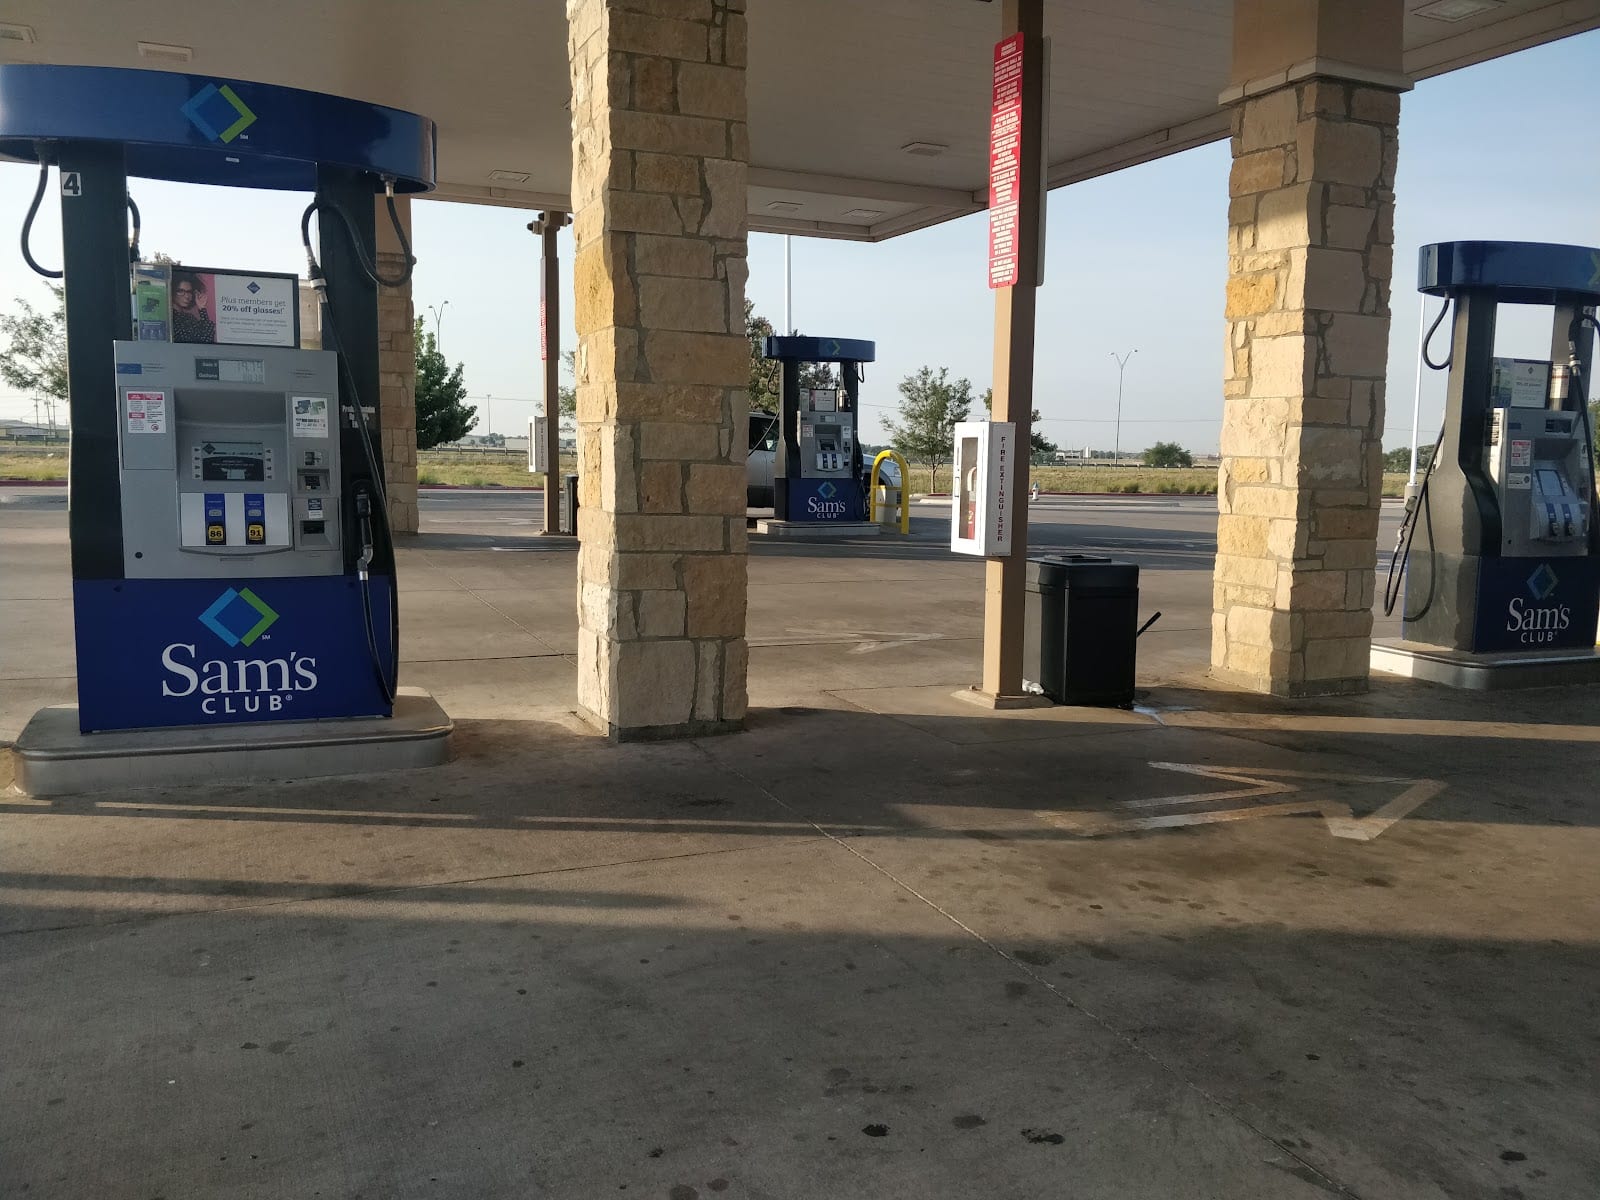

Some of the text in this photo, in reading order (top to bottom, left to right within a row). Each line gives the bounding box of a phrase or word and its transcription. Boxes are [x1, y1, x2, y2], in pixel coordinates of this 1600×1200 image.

[63, 173, 80, 195] 4
[221, 295, 286, 308] Plus members get
[222, 304, 239, 312] 20%
[240, 305, 251, 313] off
[807, 496, 846, 513] Sam's
[1506, 597, 1570, 632] Sam's
[161, 643, 318, 697] Sam's
